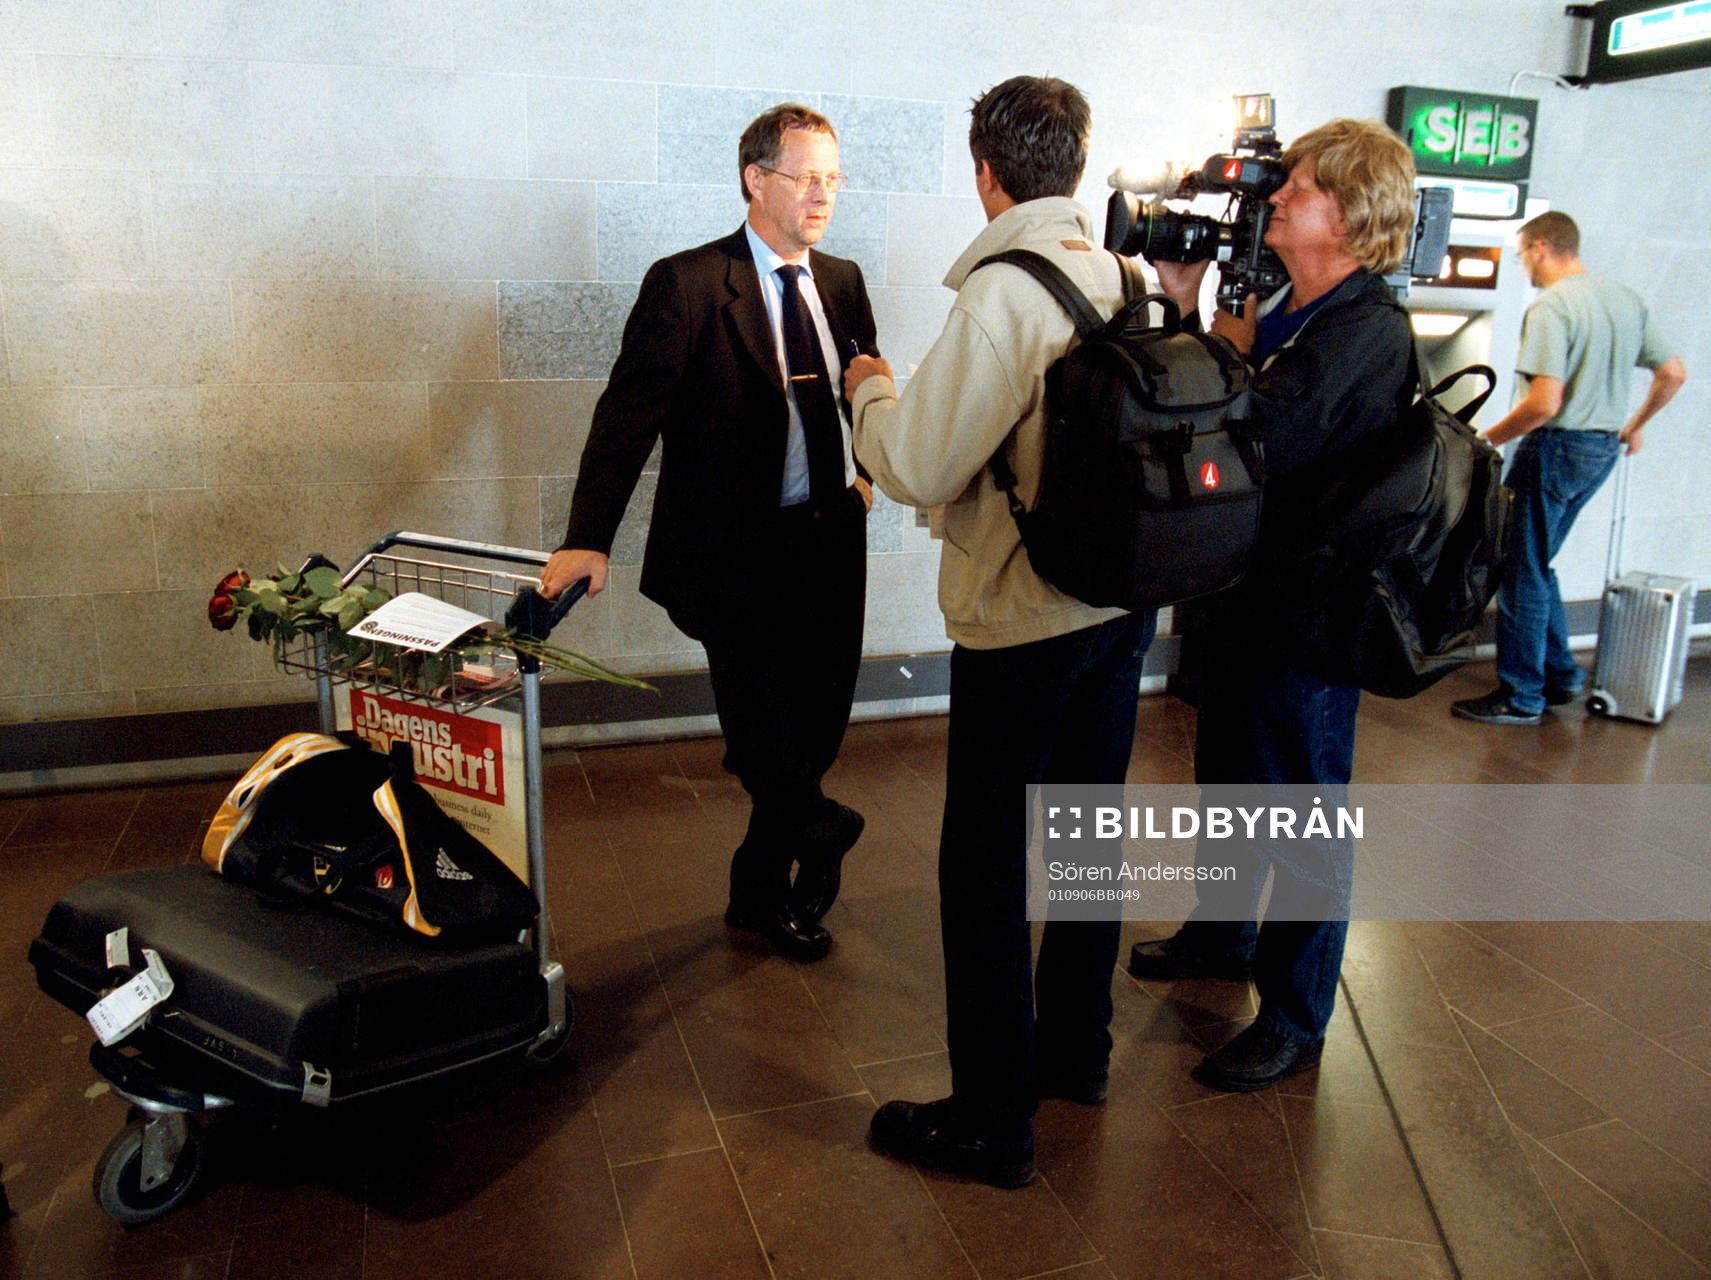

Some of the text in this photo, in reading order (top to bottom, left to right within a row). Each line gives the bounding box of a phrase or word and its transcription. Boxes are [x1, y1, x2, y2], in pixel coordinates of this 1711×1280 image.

[1424, 105, 1531, 158] SEB
[1205, 463, 1217, 487] 4
[363, 697, 452, 748] Dagens
[356, 715, 498, 796] inustri
[471, 805, 491, 822] daily
